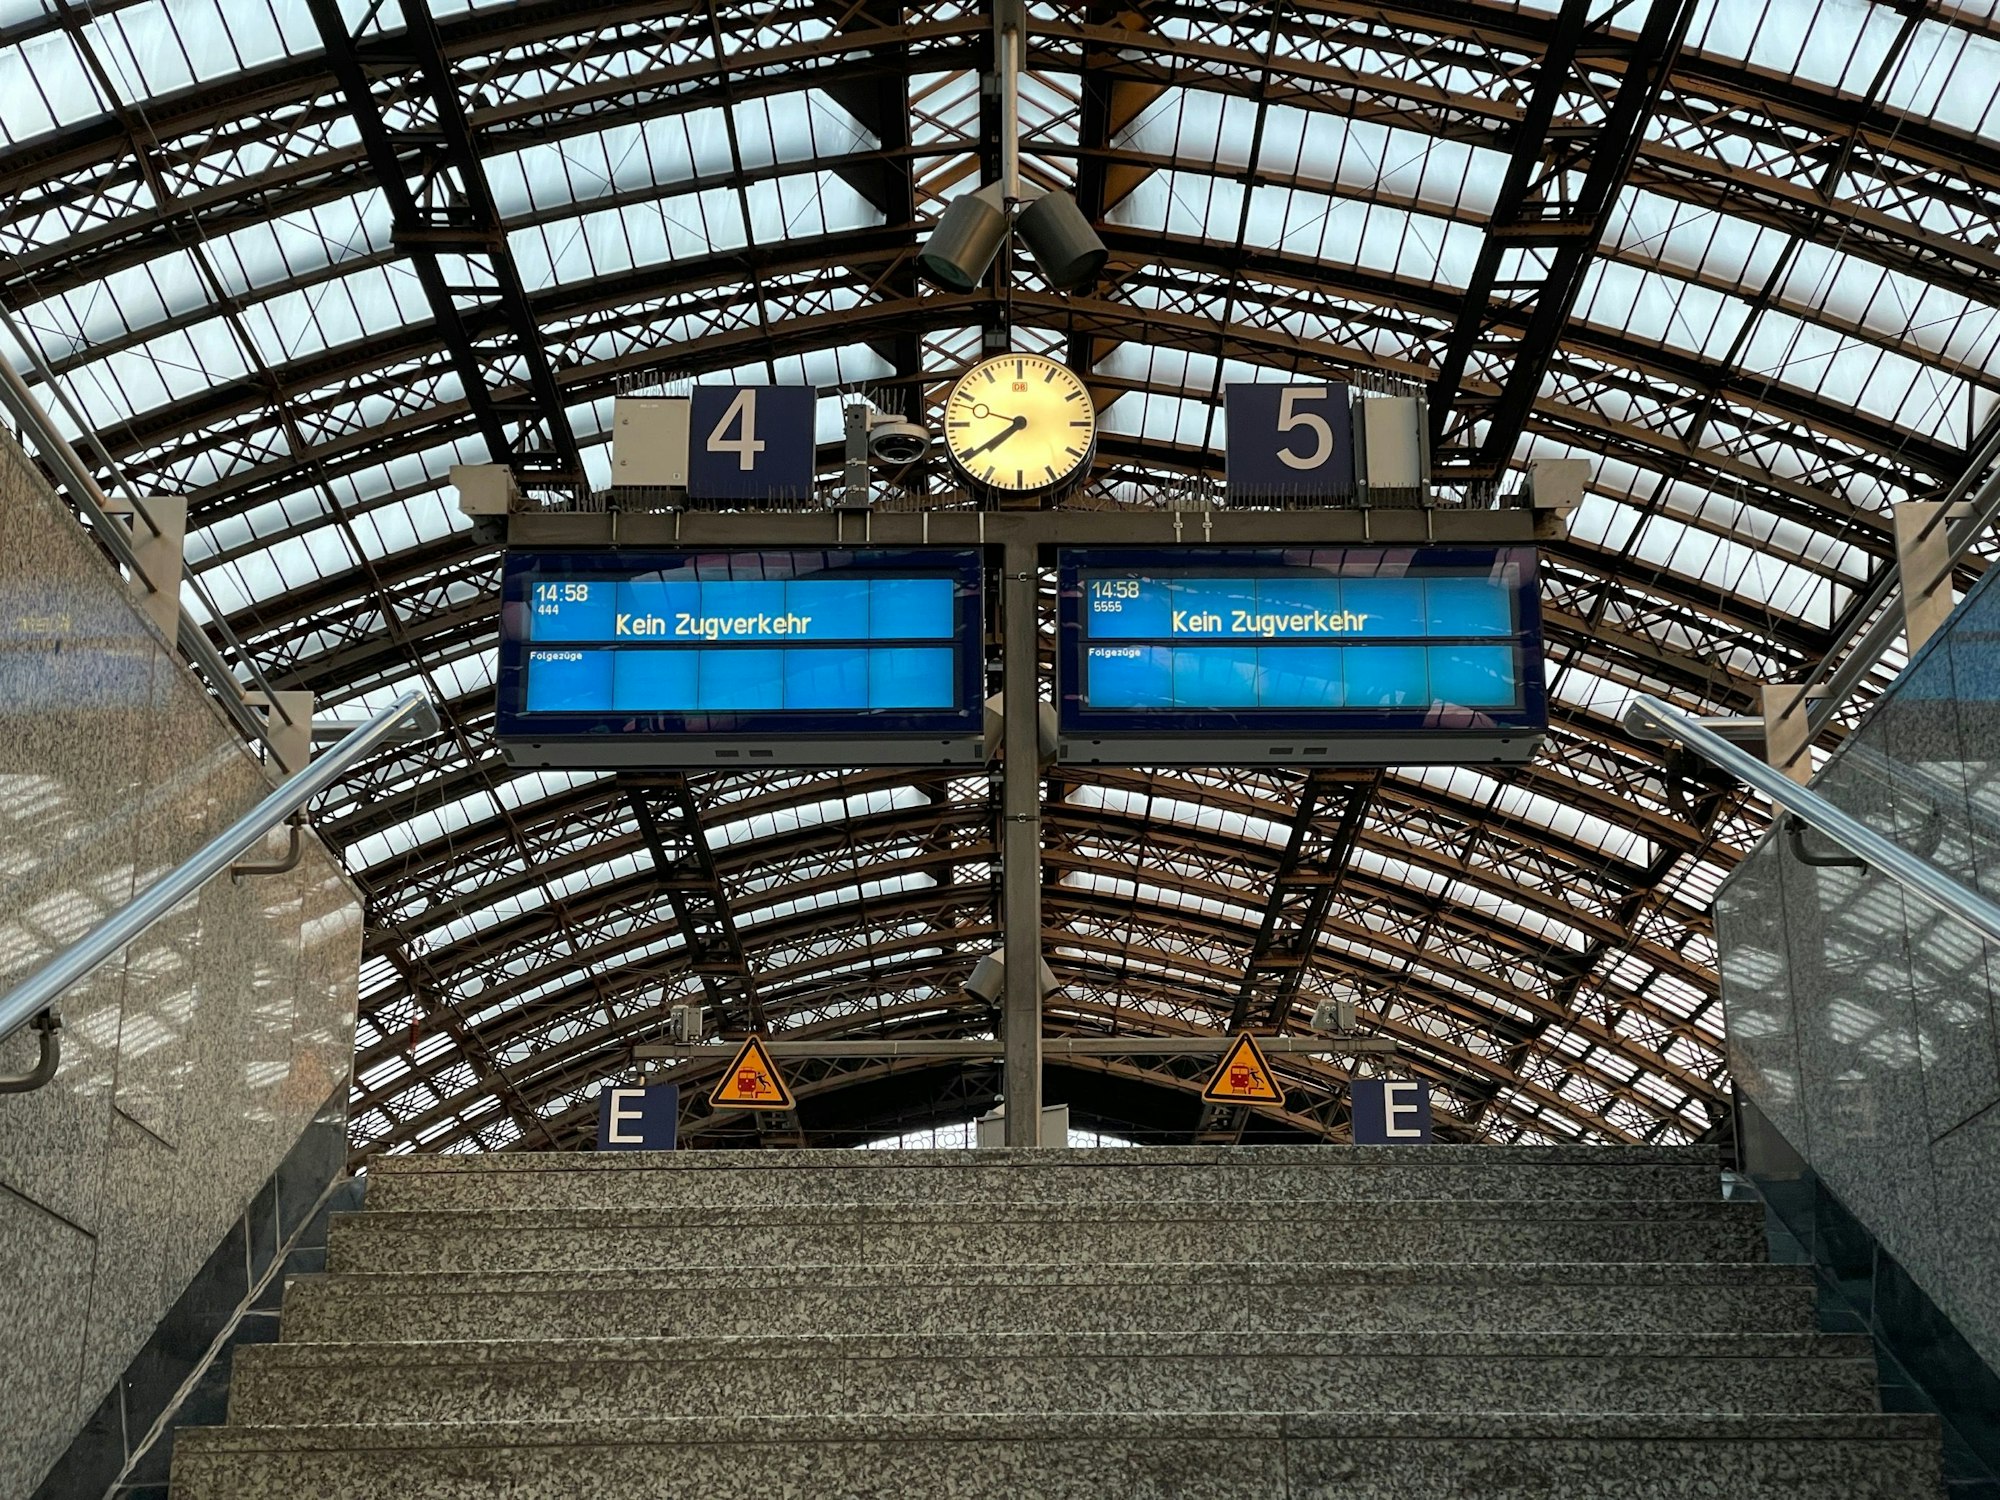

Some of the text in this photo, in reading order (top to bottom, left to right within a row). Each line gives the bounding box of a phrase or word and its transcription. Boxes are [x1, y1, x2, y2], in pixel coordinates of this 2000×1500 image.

[1013, 382, 1026, 391] DB
[706, 388, 766, 471] 4
[1276, 387, 1334, 470] 5
[536, 584, 588, 602] 14:58
[1092, 581, 1140, 599] 14:58
[538, 604, 559, 616] 444
[1094, 601, 1122, 613] 5555
[616, 613, 812, 641] Kein Zugverkehr
[1172, 610, 1368, 638] Kein Zugverkehr
[529, 651, 583, 662] Folgezüge
[1088, 647, 1141, 659] Folgezüge
[608, 1089, 646, 1144] E
[1383, 1082, 1421, 1138] E
